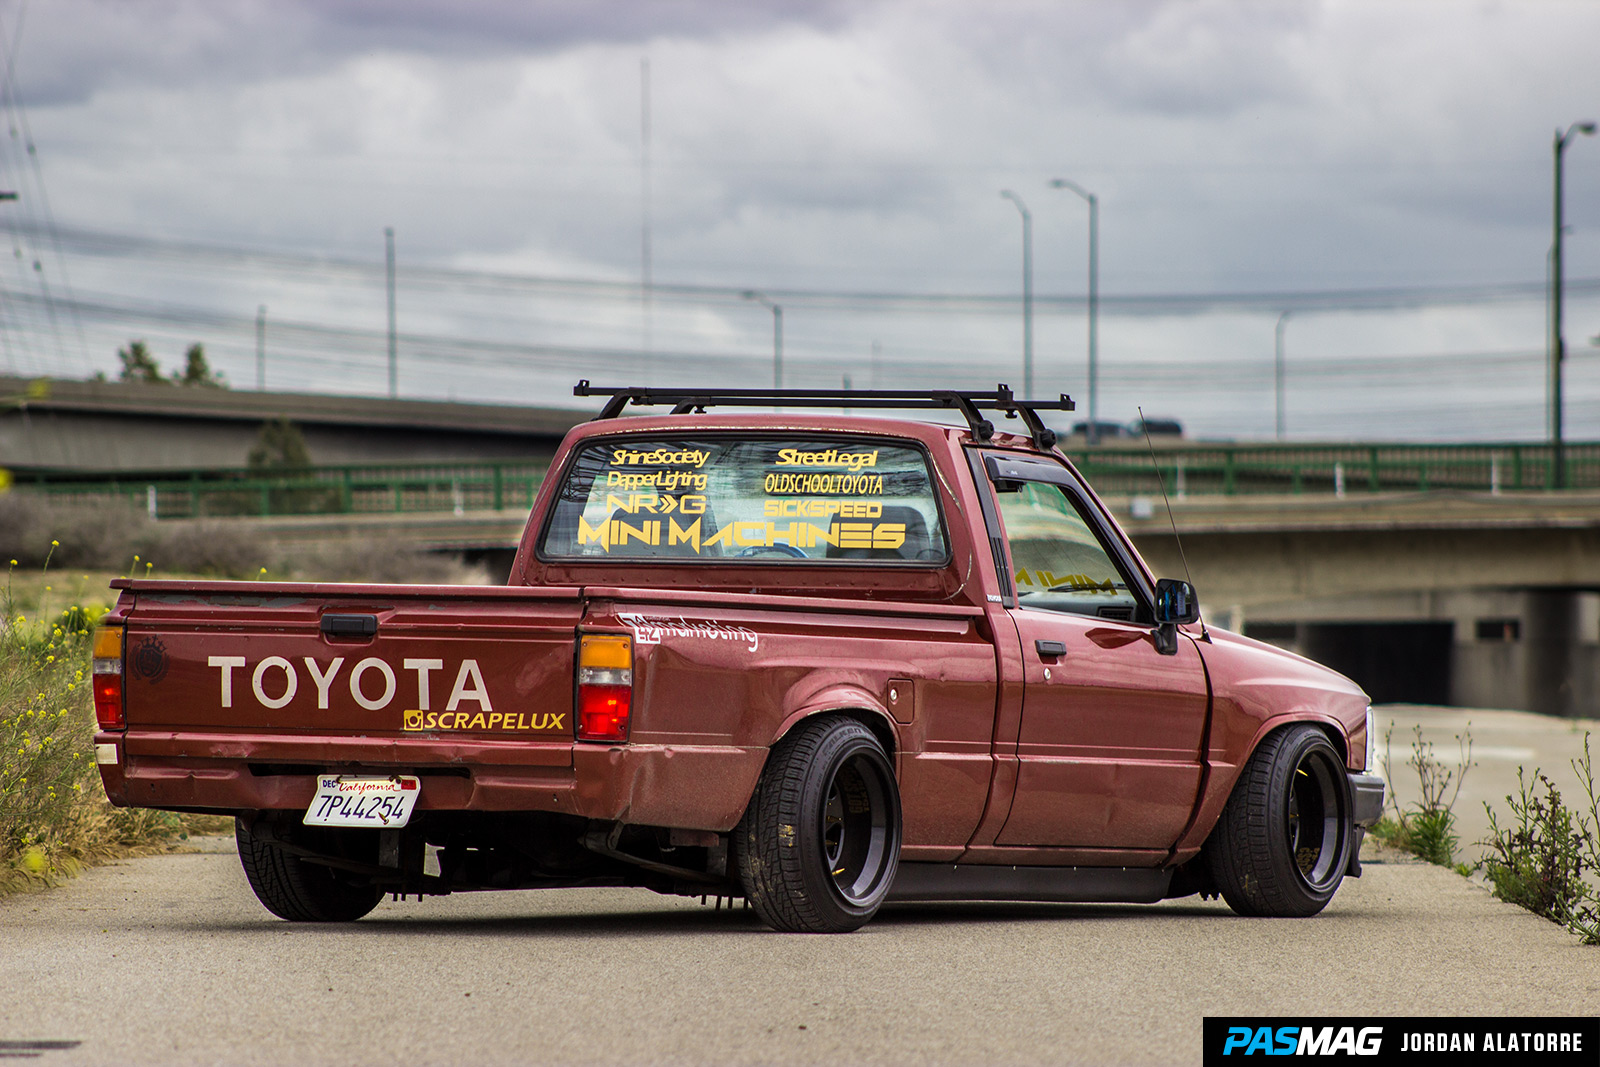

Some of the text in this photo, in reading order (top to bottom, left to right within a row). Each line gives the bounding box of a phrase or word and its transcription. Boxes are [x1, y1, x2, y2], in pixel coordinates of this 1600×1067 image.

[610, 448, 711, 468] ShineSociety
[775, 448, 879, 472] StreetLegal
[606, 470, 708, 491] DapperLighting
[764, 473, 883, 495] OLDSCHOOLTOYOTA
[763, 500, 883, 518] SICKSPEED
[577, 514, 906, 554] MINI MACHINES
[208, 655, 493, 712] TOYOTA
[424, 712, 566, 730] SCRAPELUX
[322, 779, 337, 789] DEC
[339, 782, 401, 796] California
[316, 794, 406, 820] 7P44254
